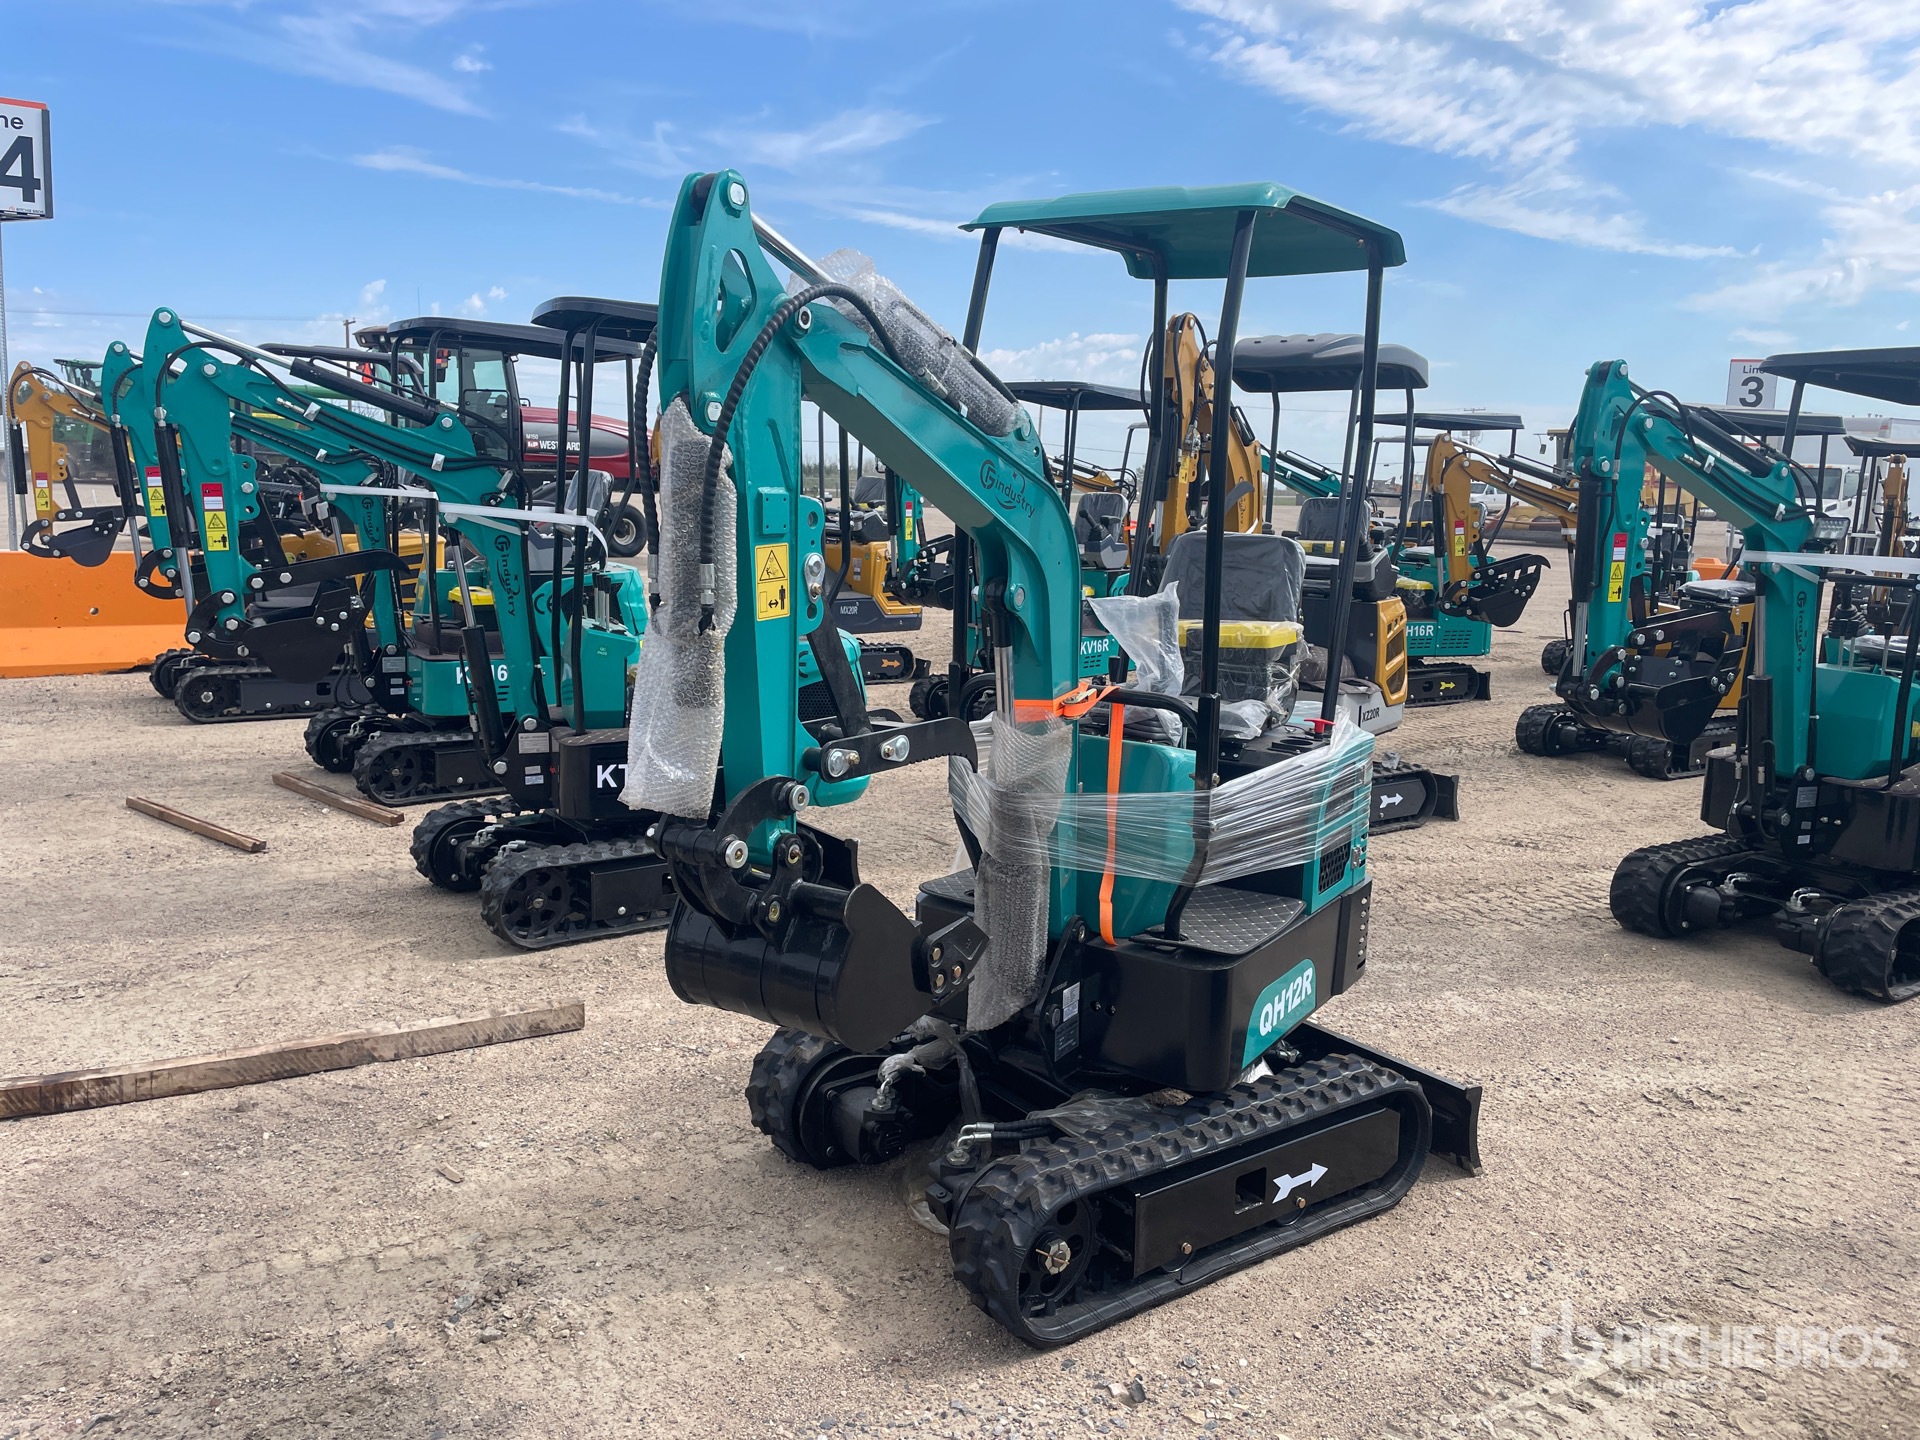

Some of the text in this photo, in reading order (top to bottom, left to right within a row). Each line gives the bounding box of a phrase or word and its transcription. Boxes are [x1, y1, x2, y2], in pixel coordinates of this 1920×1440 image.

[0, 114, 24, 130] ne
[0, 135, 41, 204] 4
[1739, 376, 1764, 408] 3
[539, 440, 581, 451] WESTARD
[1405, 625, 1434, 637] H16R
[1080, 638, 1110, 656] KV16R
[596, 764, 630, 789] KT
[1259, 967, 1314, 1037] QH12R
